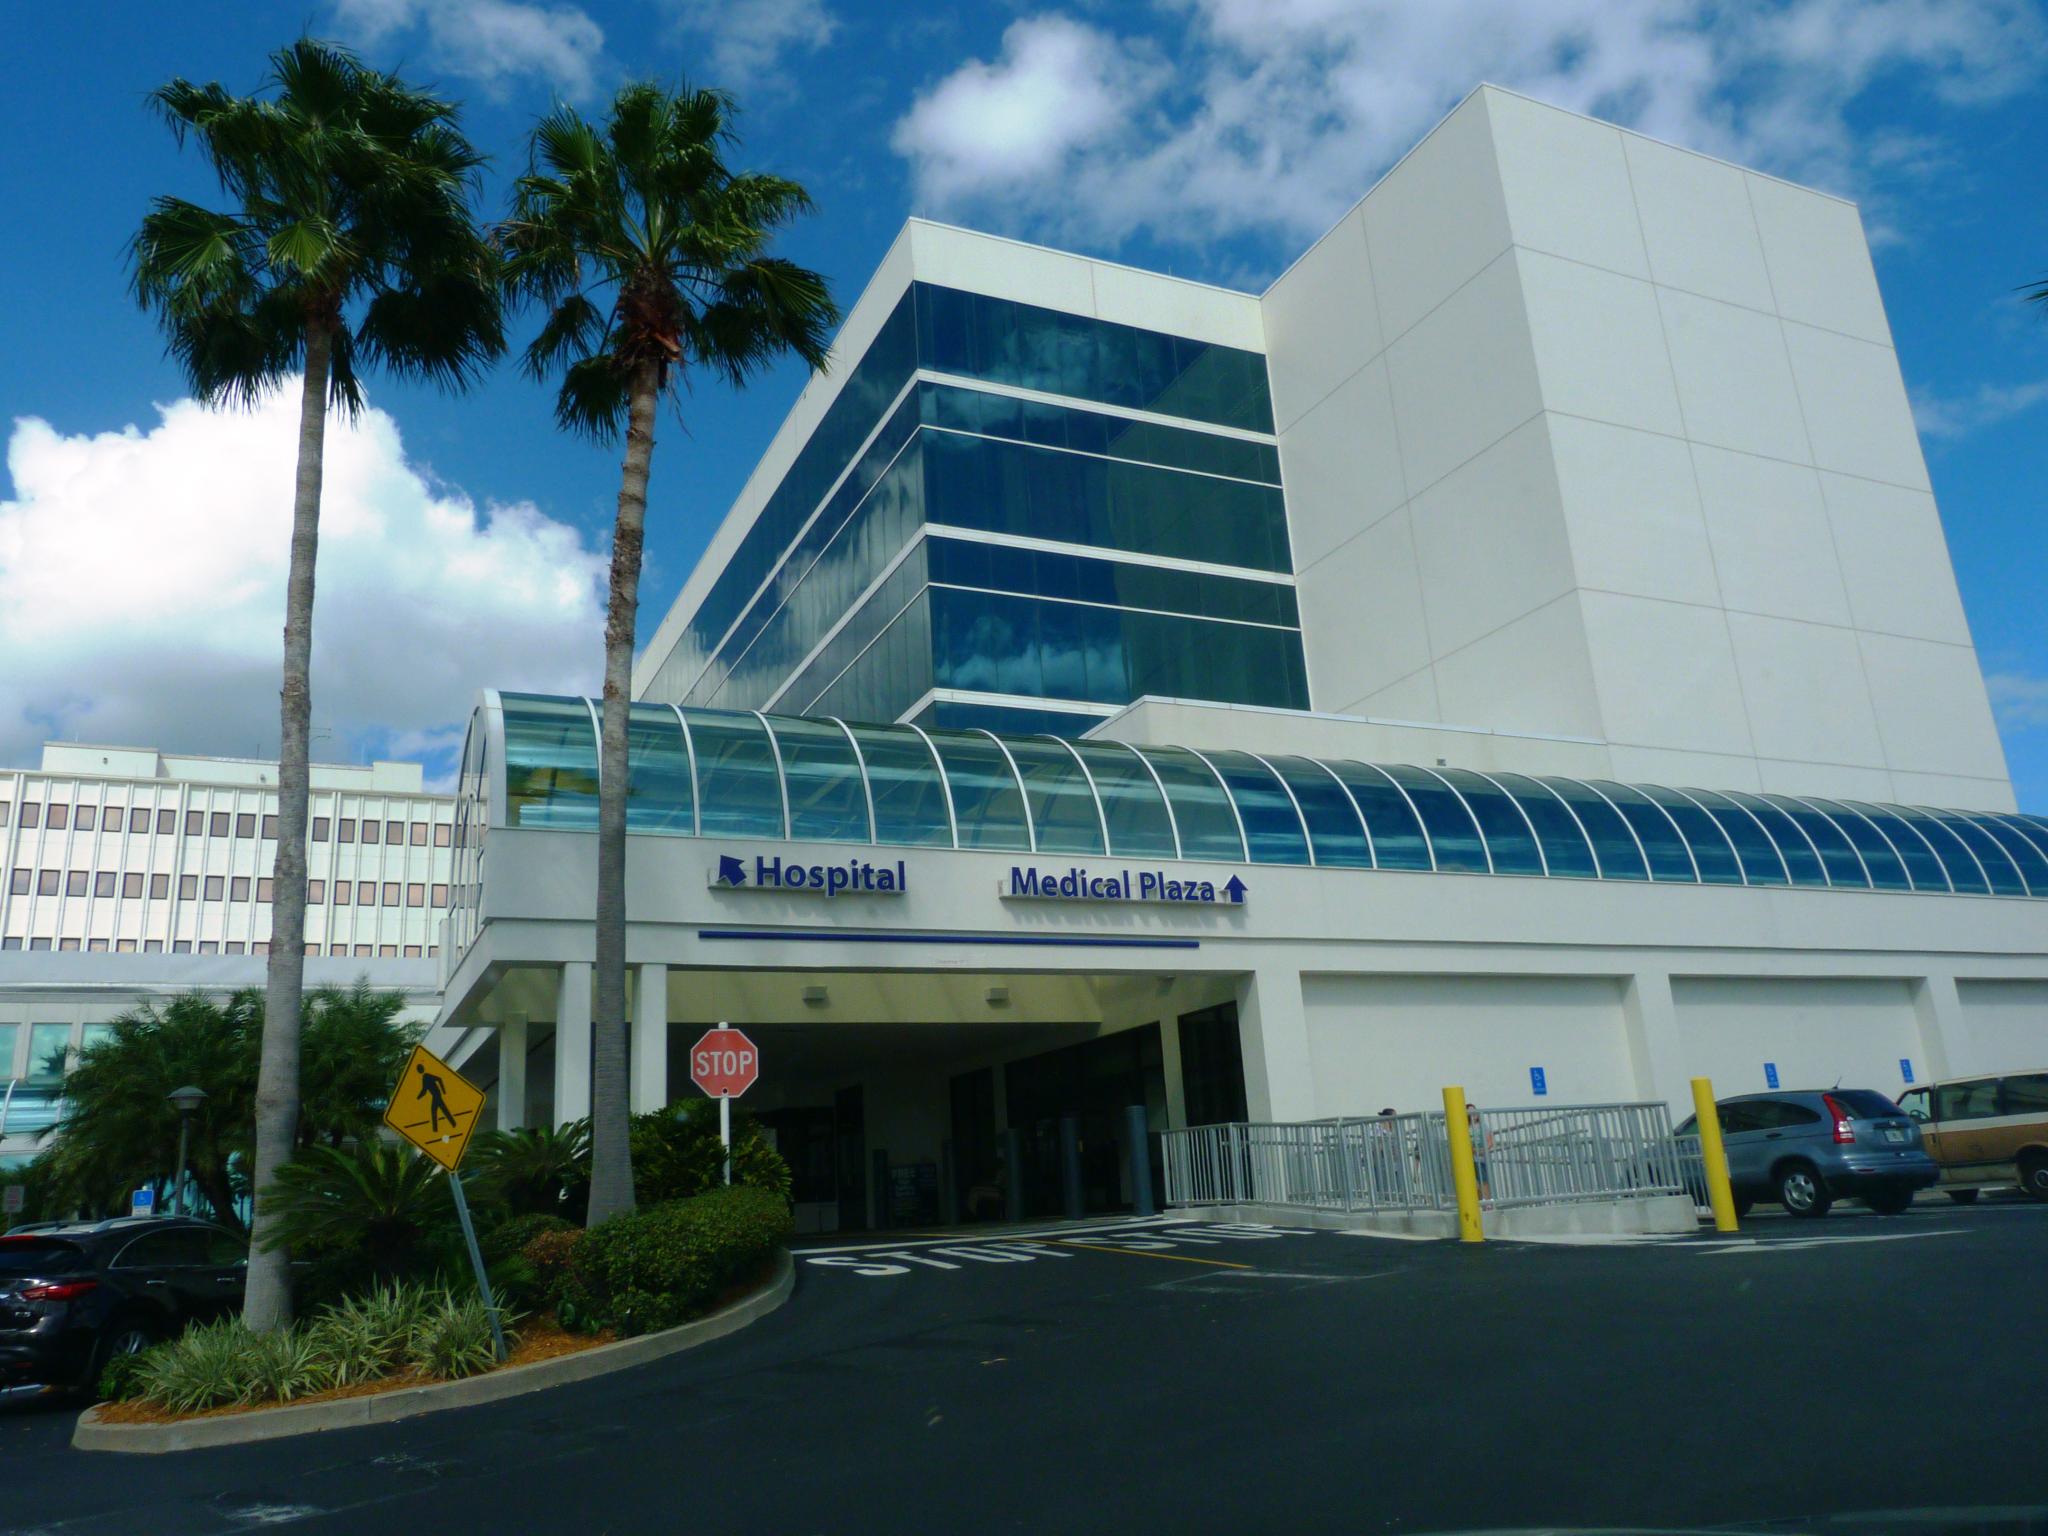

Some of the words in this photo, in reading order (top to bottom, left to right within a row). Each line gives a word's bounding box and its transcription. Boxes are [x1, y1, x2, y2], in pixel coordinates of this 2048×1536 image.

[757, 856, 905, 896] Hospital
[1011, 867, 1130, 898] Medical
[1139, 871, 1216, 901] Plaza
[696, 1051, 752, 1076] STOP
[1058, 1223, 1317, 1250] STOP
[806, 1242, 1075, 1276] STOP
